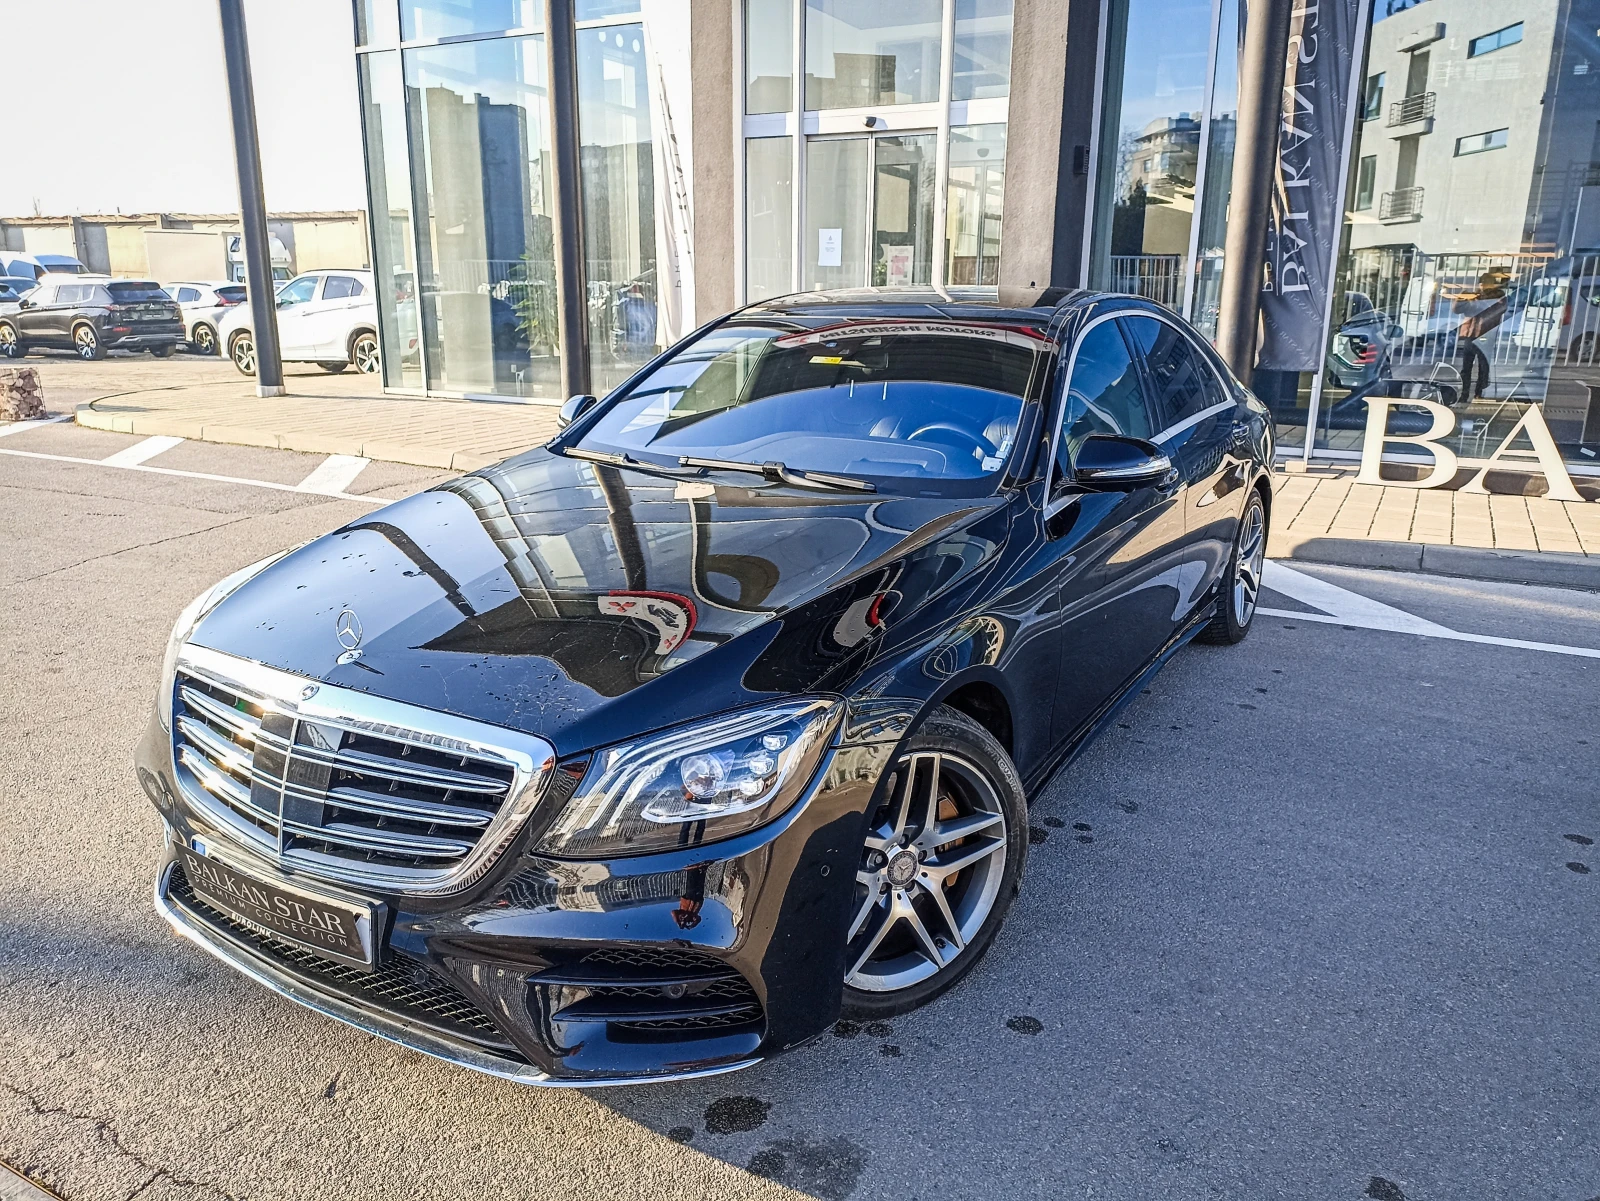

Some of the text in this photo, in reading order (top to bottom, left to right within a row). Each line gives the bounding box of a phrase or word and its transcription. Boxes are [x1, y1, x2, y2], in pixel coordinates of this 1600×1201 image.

[1354, 396, 1600, 503] BA
[185, 853, 347, 935] BALKAN STAR
[194, 875, 348, 947] PREMIUM COLLECTION
[231, 912, 272, 938] EUROLINK
